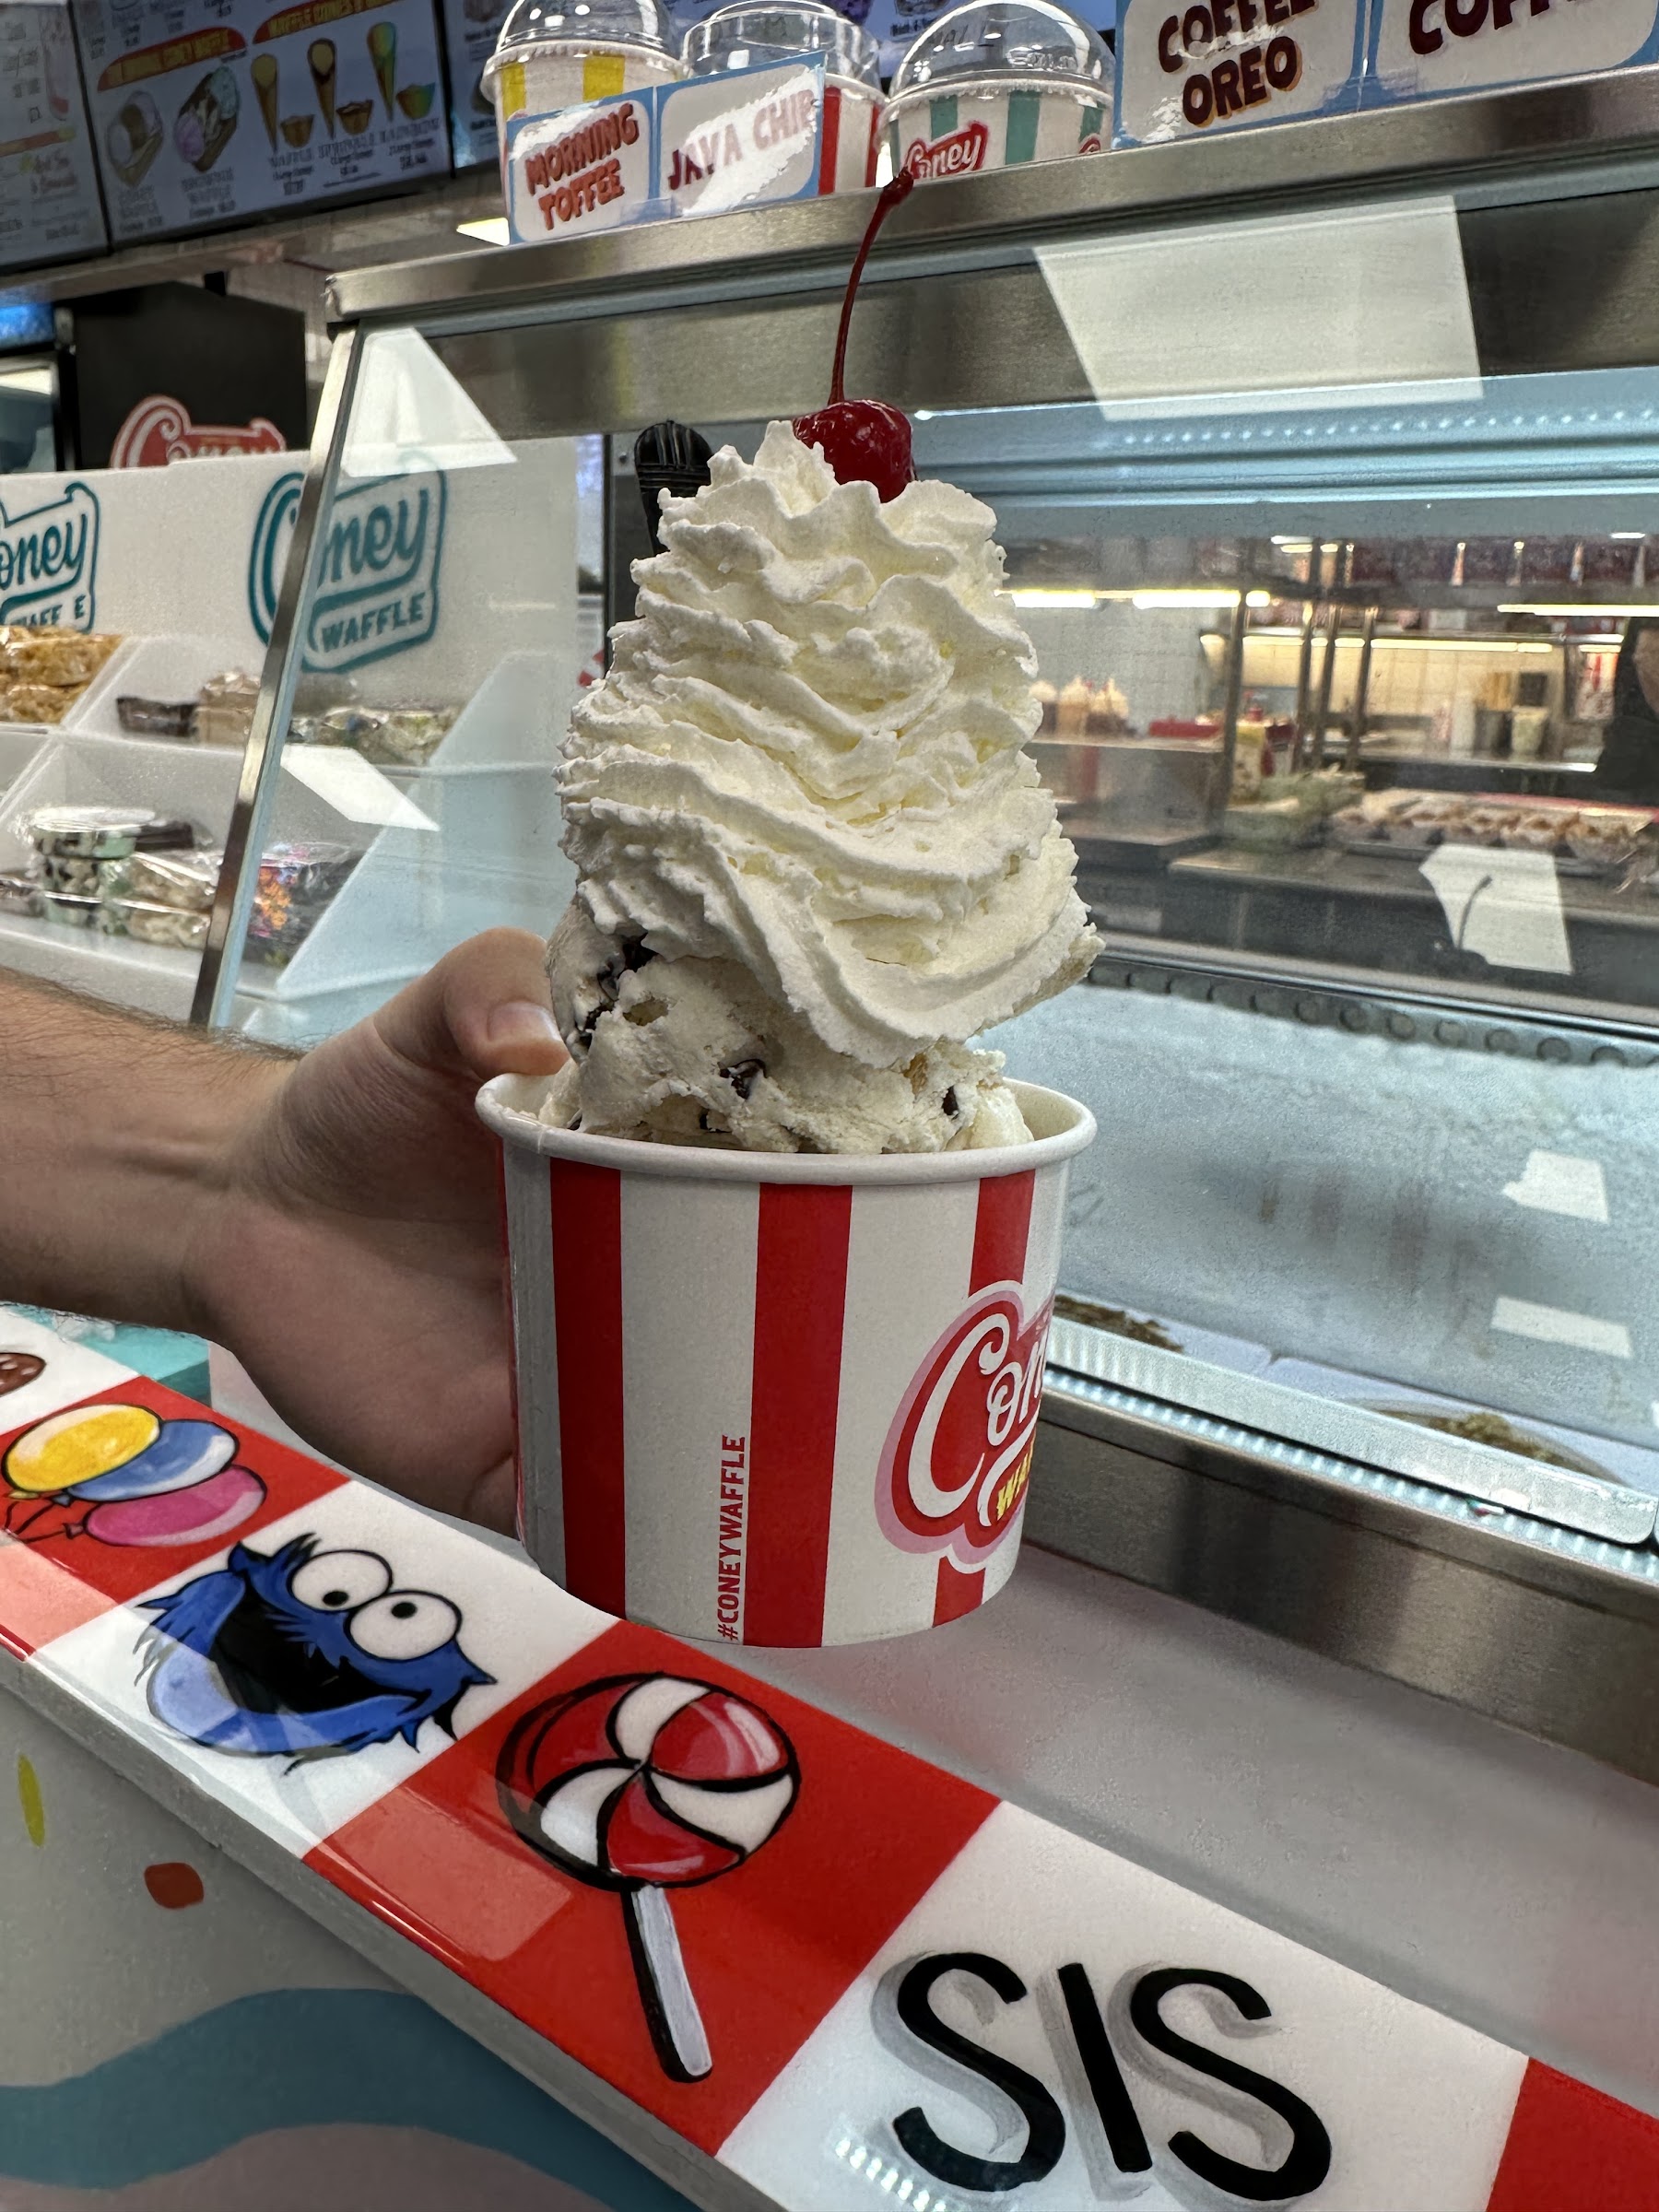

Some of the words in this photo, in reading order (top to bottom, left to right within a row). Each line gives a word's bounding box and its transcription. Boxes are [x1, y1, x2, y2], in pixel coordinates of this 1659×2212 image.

[1182, 36, 1302, 127] OREO
[525, 102, 640, 196] MORNING
[668, 124, 743, 191] JAVA
[753, 89, 815, 150] CHIP
[538, 158, 626, 230] TOFFEE
[323, 592, 426, 653] WAFFLE
[717, 1434, 746, 1641] #CONEYWAFFLE
[892, 1950, 1333, 2203] SIS
